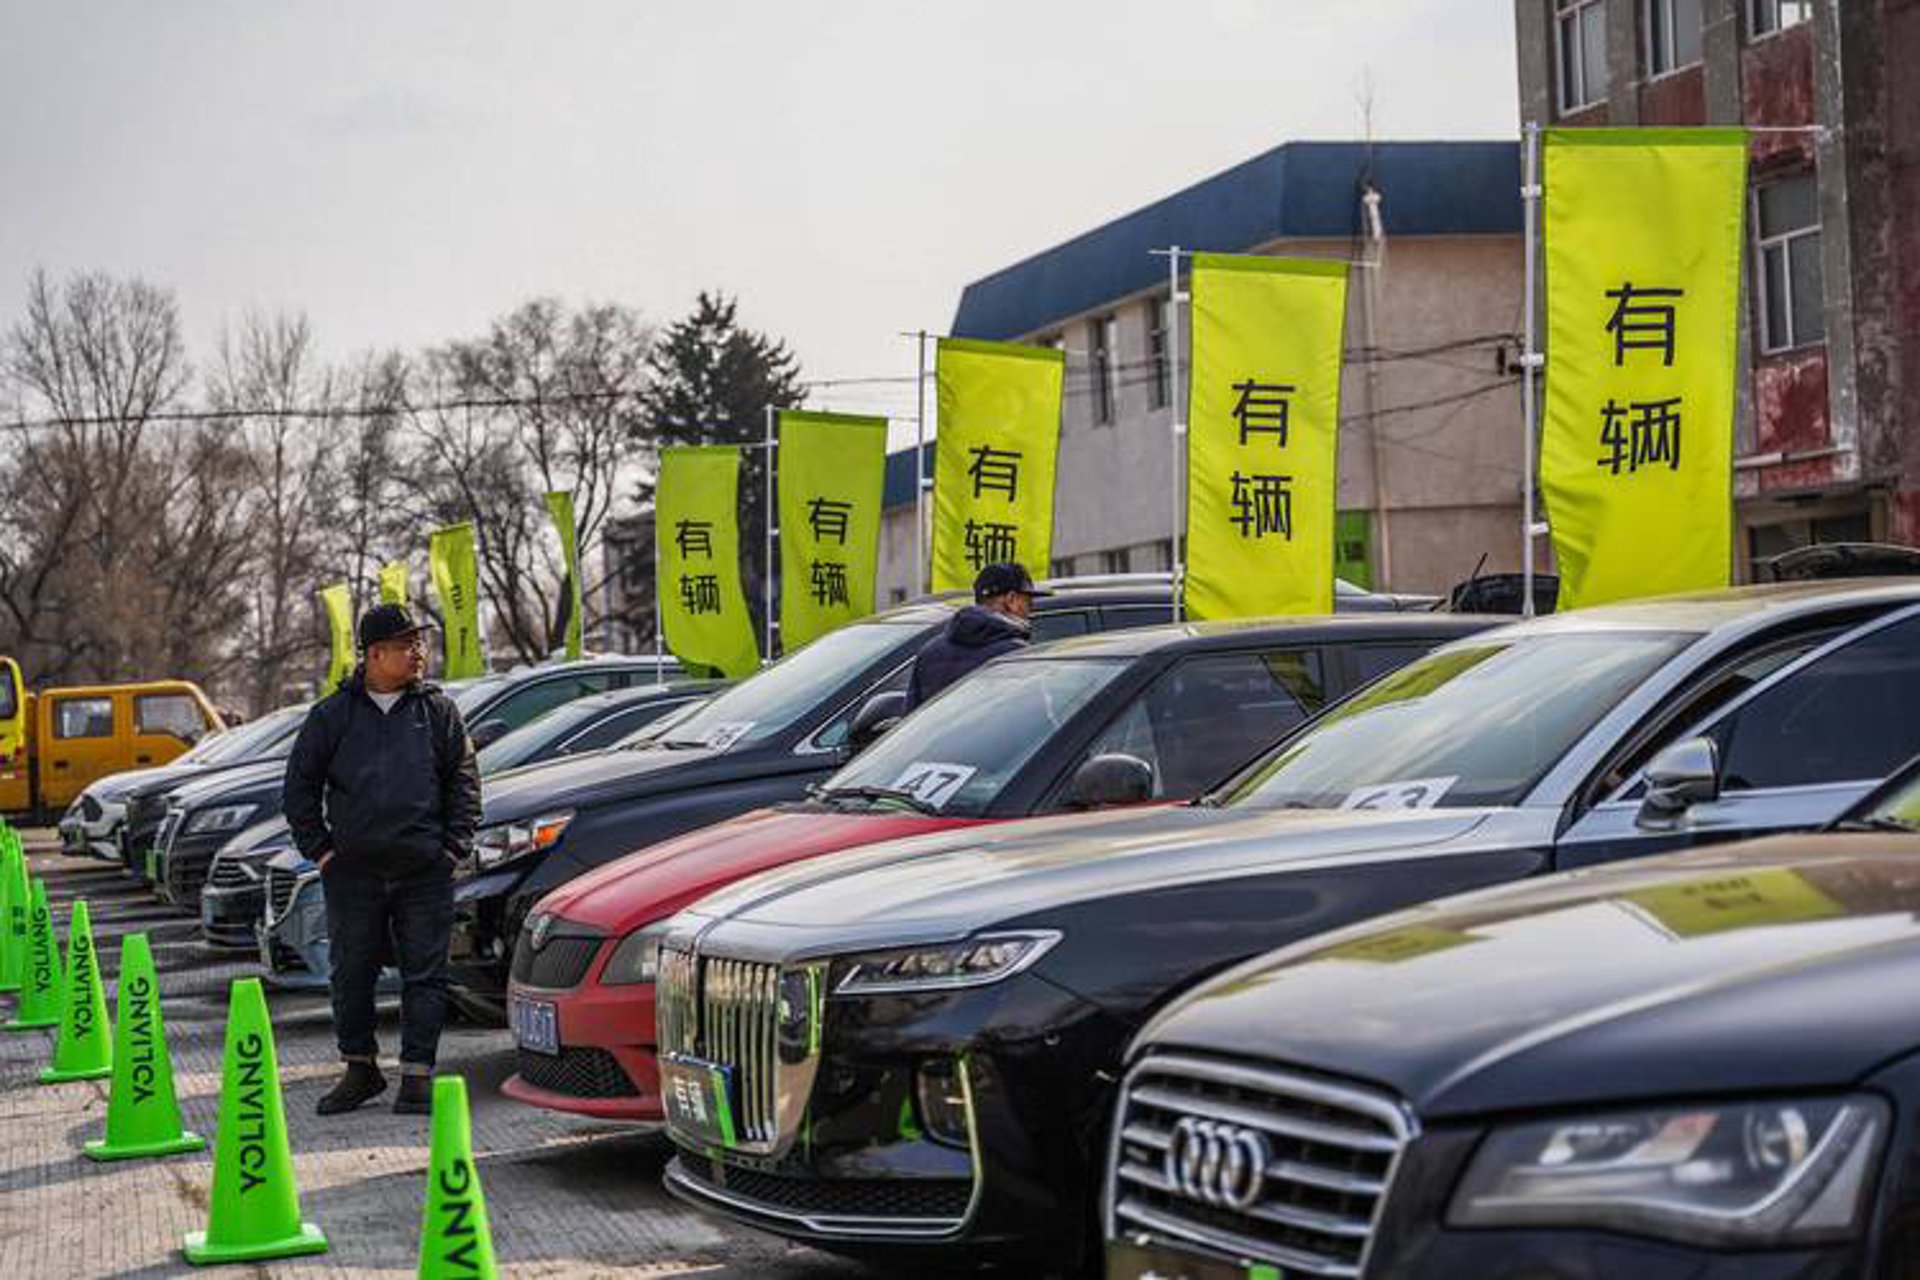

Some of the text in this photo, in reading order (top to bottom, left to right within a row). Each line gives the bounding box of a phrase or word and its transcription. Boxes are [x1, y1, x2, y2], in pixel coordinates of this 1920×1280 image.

[1597, 281, 1684, 475] 有辆
[964, 444, 1023, 564] 有辆
[1229, 378, 1296, 542] 有辆
[675, 519, 721, 615] 有辆
[806, 496, 853, 609] 有辆
[33, 907, 50, 993] YOLIANG
[74, 934, 92, 1039] YOLIANG
[128, 976, 155, 1104] YOLIANG
[237, 1033, 267, 1194] YOLIANG
